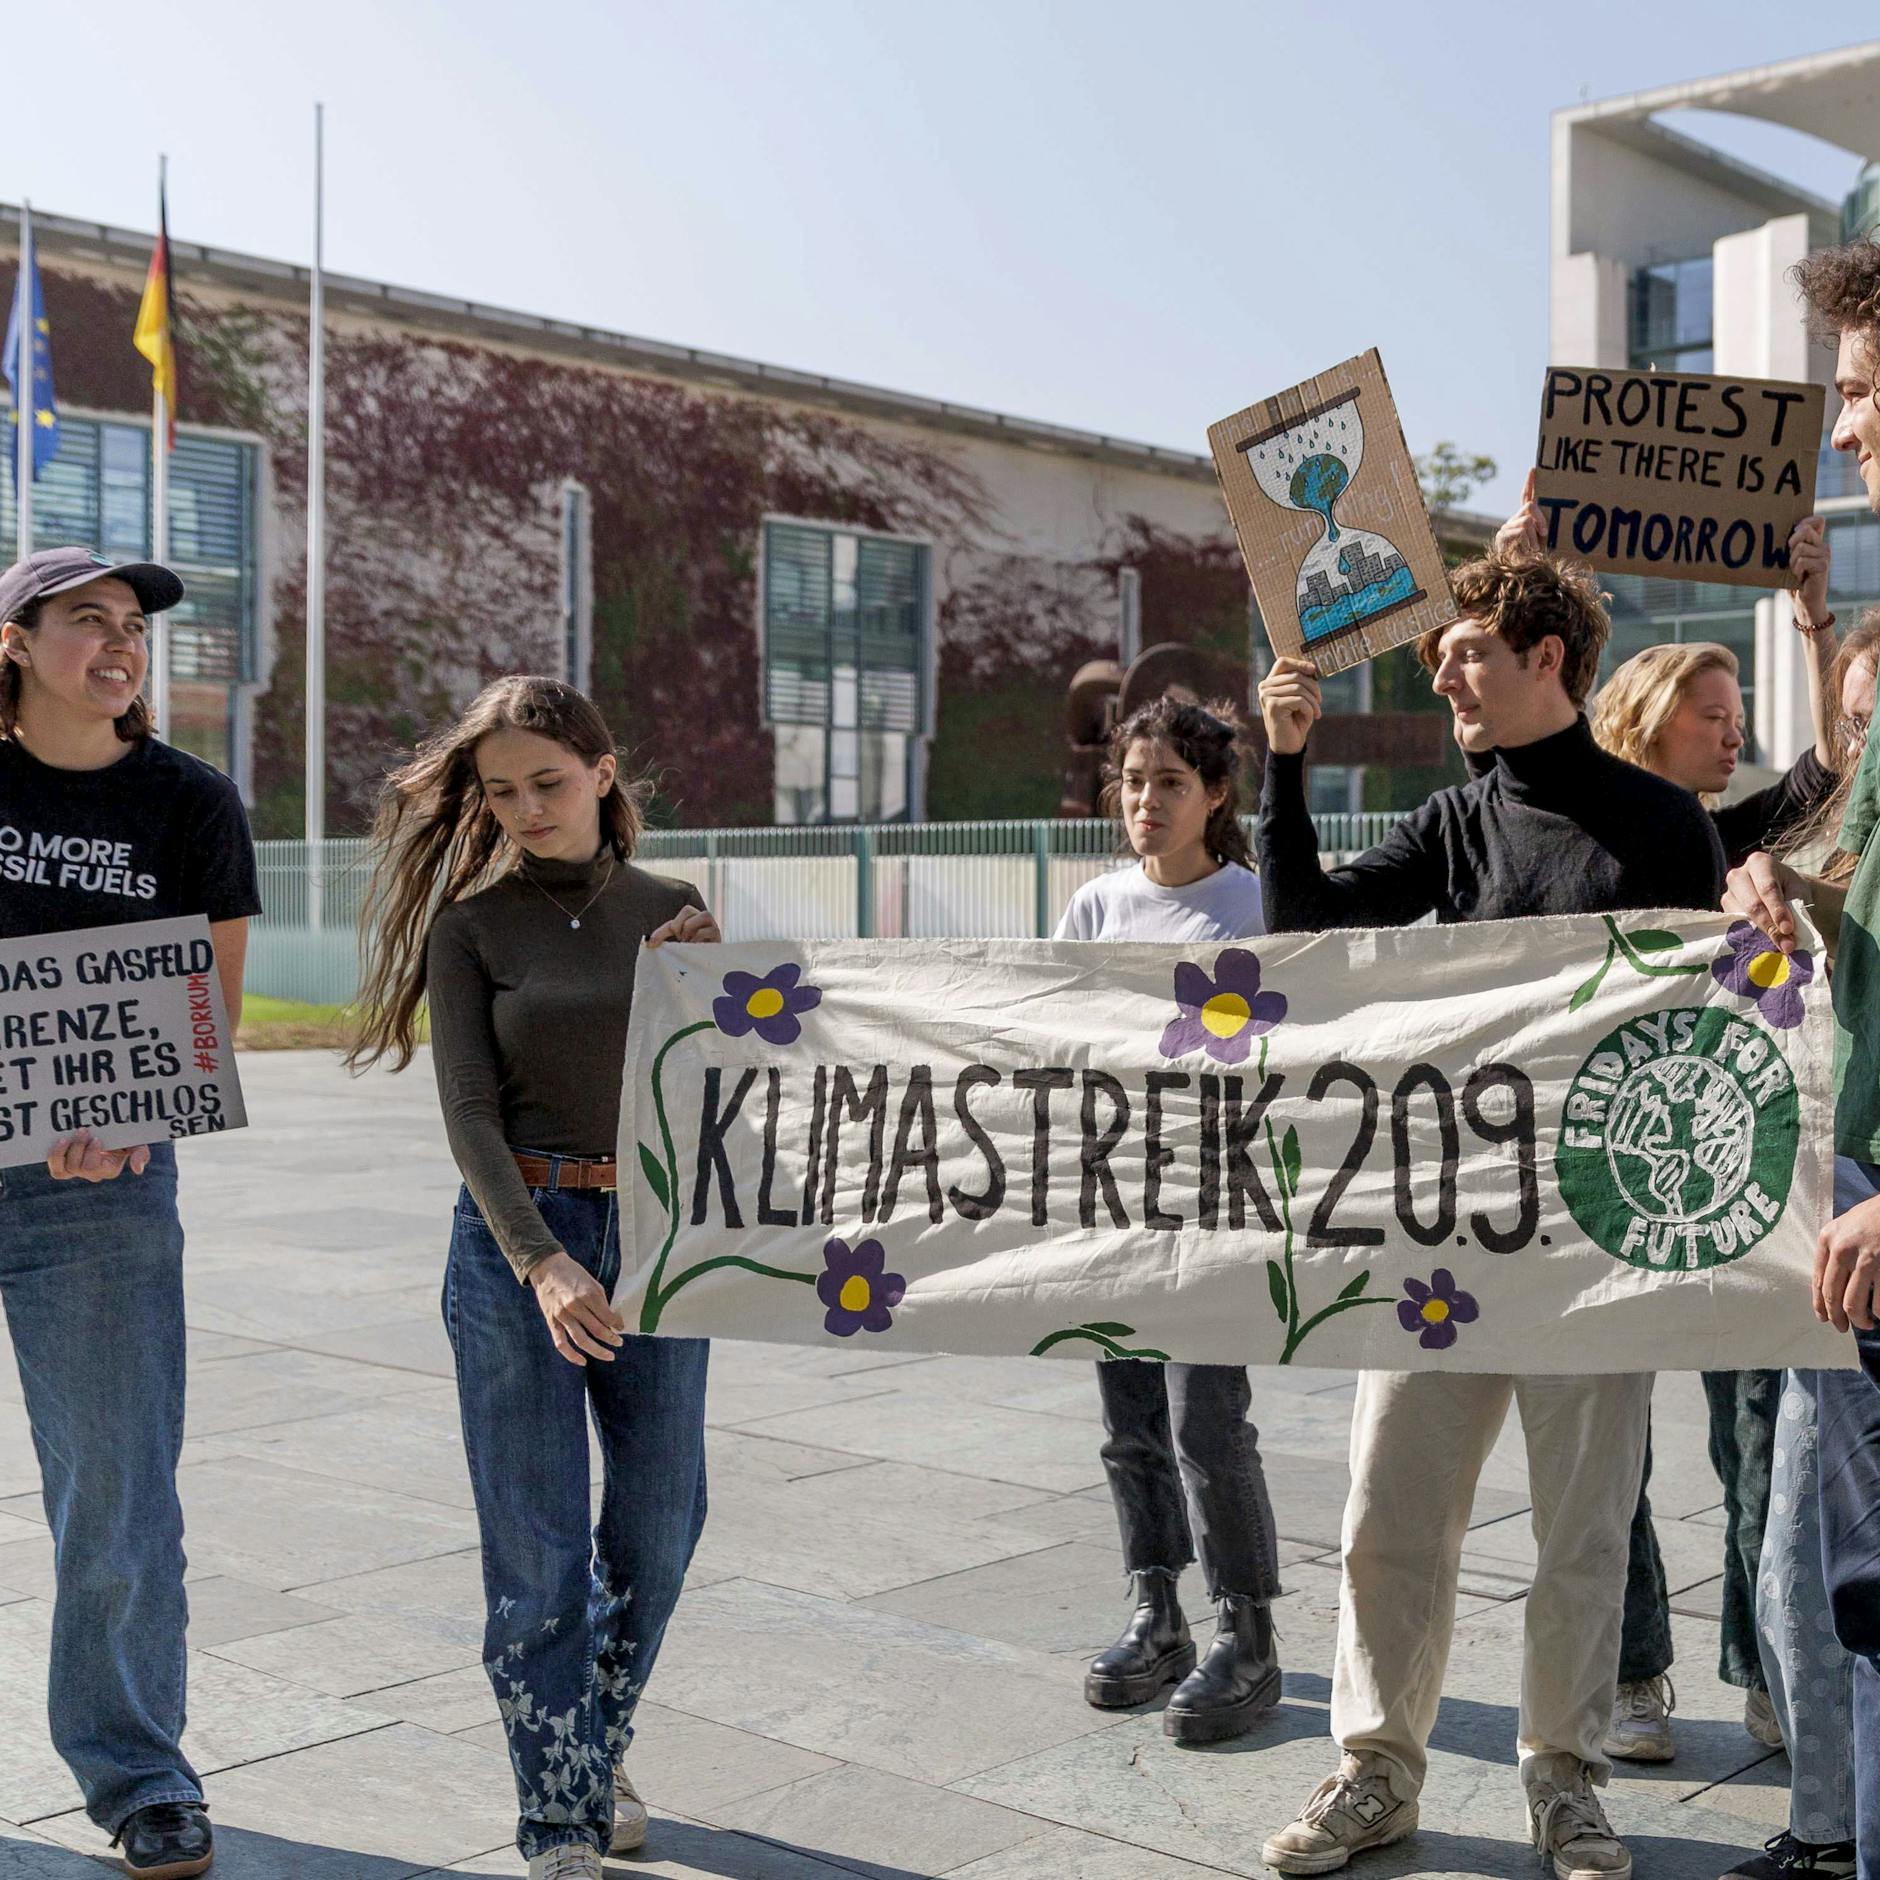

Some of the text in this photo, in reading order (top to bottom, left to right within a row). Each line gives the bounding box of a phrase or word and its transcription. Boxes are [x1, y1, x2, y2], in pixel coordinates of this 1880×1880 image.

[1546, 370, 1805, 446] PROTEST
[1537, 434, 1802, 496] LIKE THERE IS A
[1537, 497, 1797, 570] TOMORROW
[1313, 633, 1372, 674] mate
[28, 832, 133, 866] MORE
[0, 853, 158, 899] SIL FUELS
[76, 939, 213, 985] GASFELD
[0, 999, 160, 1049] RENZE,
[186, 972, 219, 1073] #BORKUM
[53, 1049, 117, 1086] IHR
[130, 1042, 181, 1079] ES
[1564, 1011, 1791, 1148] FRIDAYS FOR
[51, 1083, 222, 1132] GESCHLOS
[169, 1113, 226, 1139] SEN
[690, 1061, 1552, 1253] KLIMASTREIK 20.9.
[1619, 1181, 1780, 1268] FUTURE
